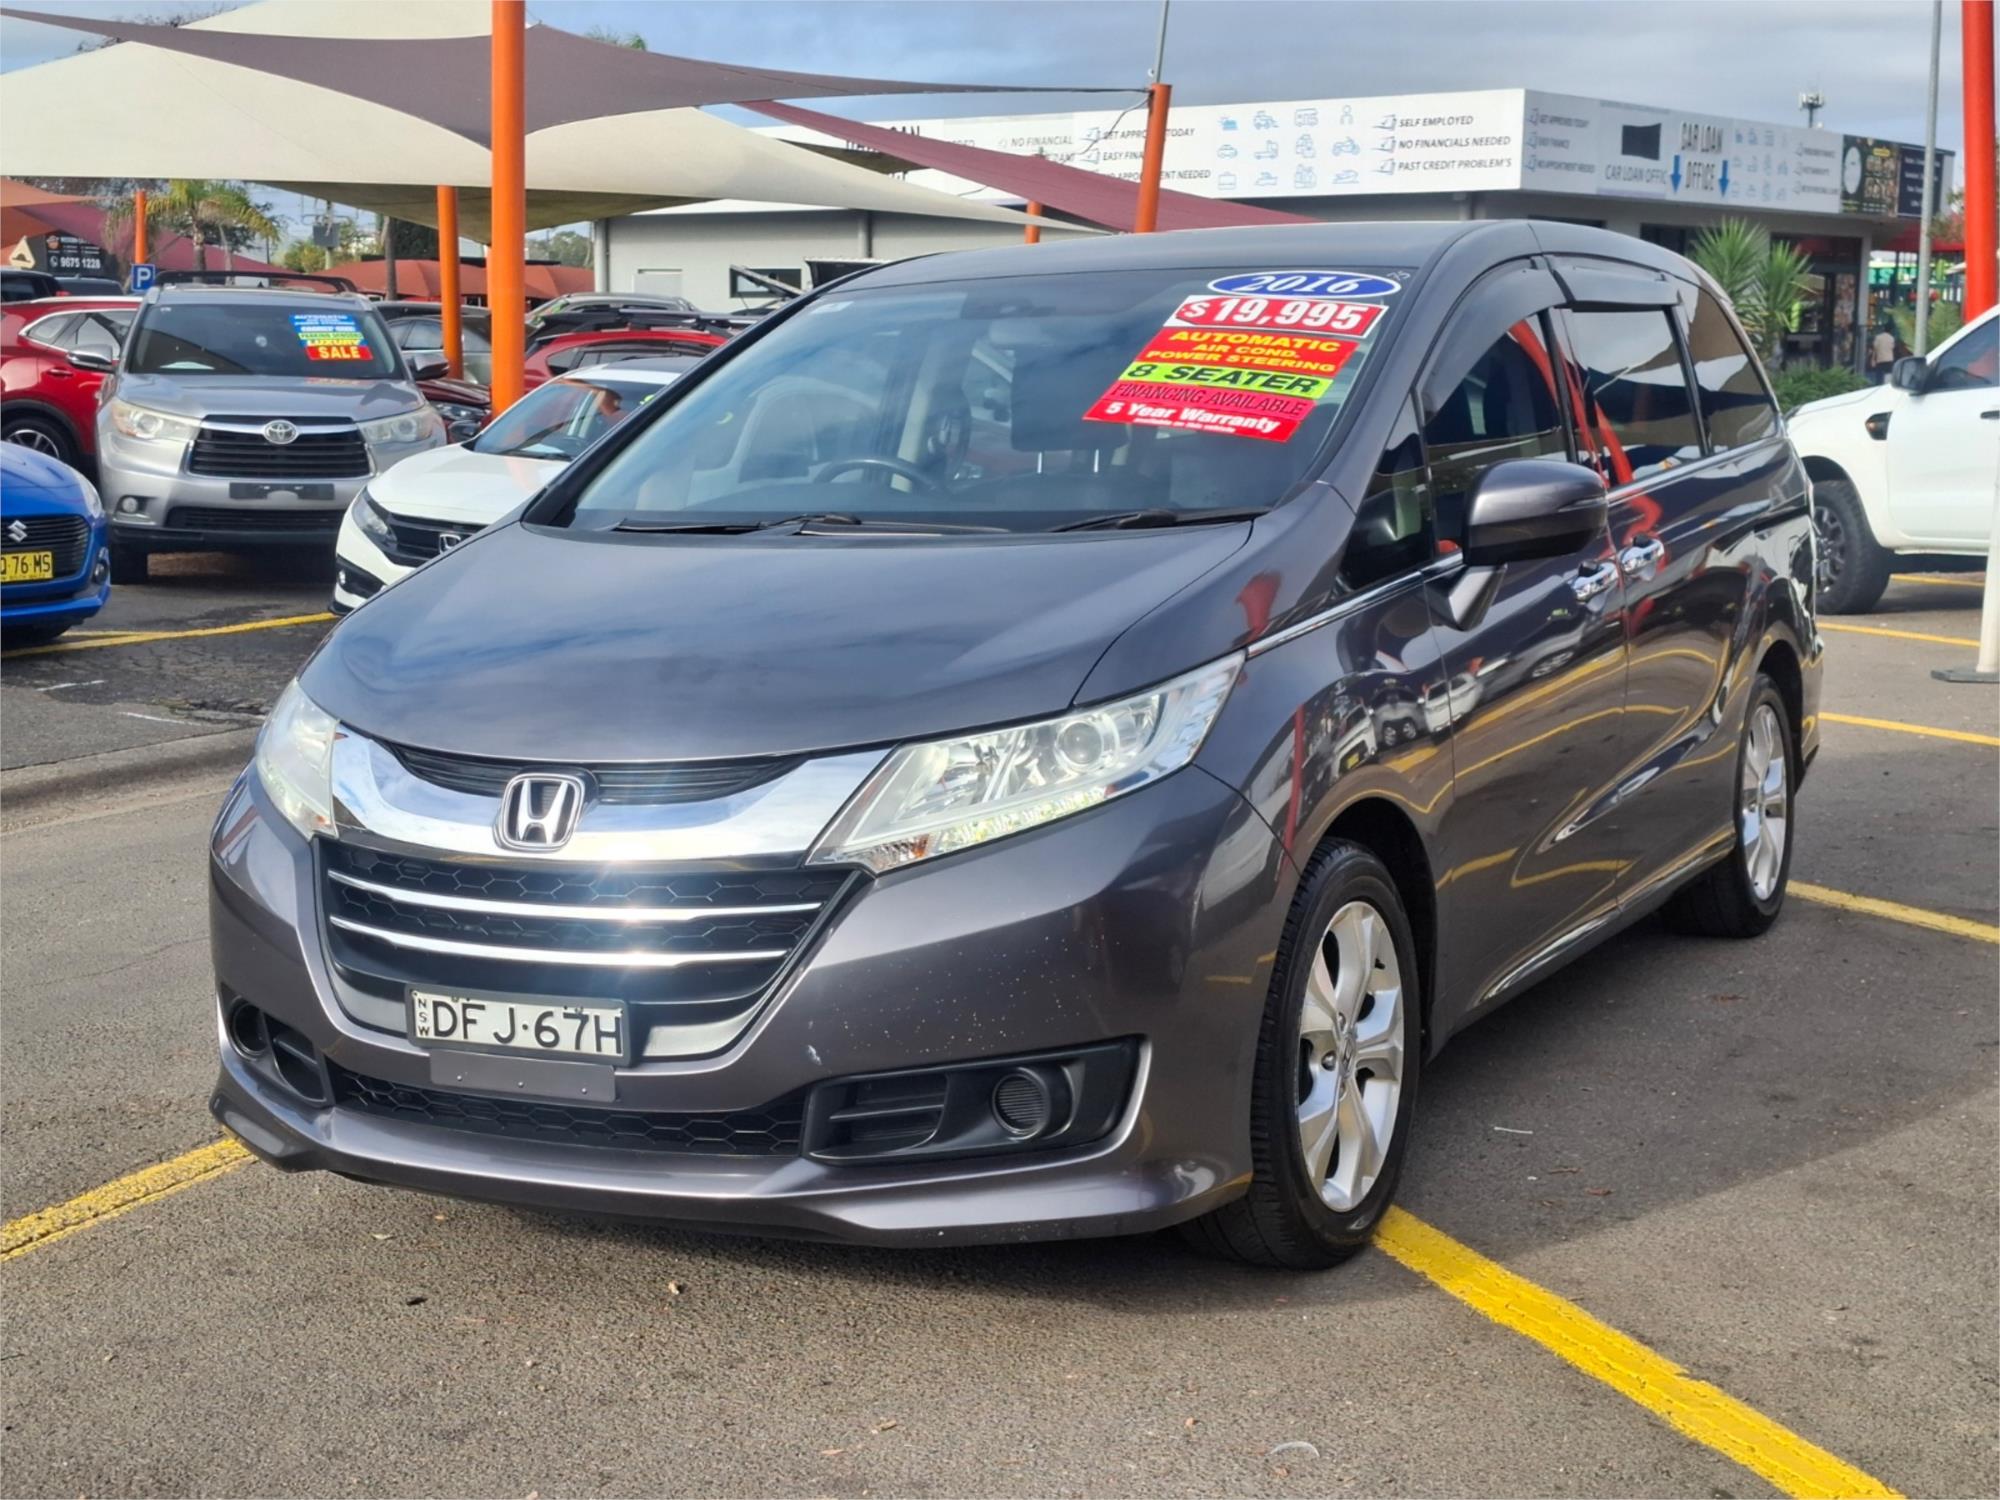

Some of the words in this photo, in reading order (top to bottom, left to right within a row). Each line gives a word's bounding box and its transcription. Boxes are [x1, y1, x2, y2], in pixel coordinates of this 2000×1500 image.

[1399, 118, 1422, 128] SELF
[1423, 115, 1474, 127] EMPLOYED
[1399, 140, 1413, 149] NO
[1415, 137, 1470, 149] FINANCIALS
[1472, 136, 1511, 147] NEEDED
[1398, 161, 1421, 171] PAST
[1422, 159, 1455, 170] CREDIT
[1457, 156, 1512, 169] PROBLEM'S
[137, 267, 151, 288] P
[1232, 275, 1372, 293] 2016
[1184, 298, 1369, 330] $19,995
[1169, 331, 1342, 352] AUTOMATIC
[1193, 343, 1229, 353] AIR
[1235, 346, 1301, 358] COND.
[318, 346, 361, 359] SALE
[1146, 350, 1221, 361] POWER
[1226, 353, 1336, 372] STEERING
[1128, 364, 1156, 379] 8
[1164, 366, 1321, 393] SEATER
[1111, 382, 1203, 402] FINANCING
[1207, 391, 1308, 416] AVAILABLE
[1106, 401, 1125, 415] 5
[1127, 402, 1176, 419] Year
[1179, 406, 1281, 433] Warranty
[417, 998, 431, 1037] NSW
